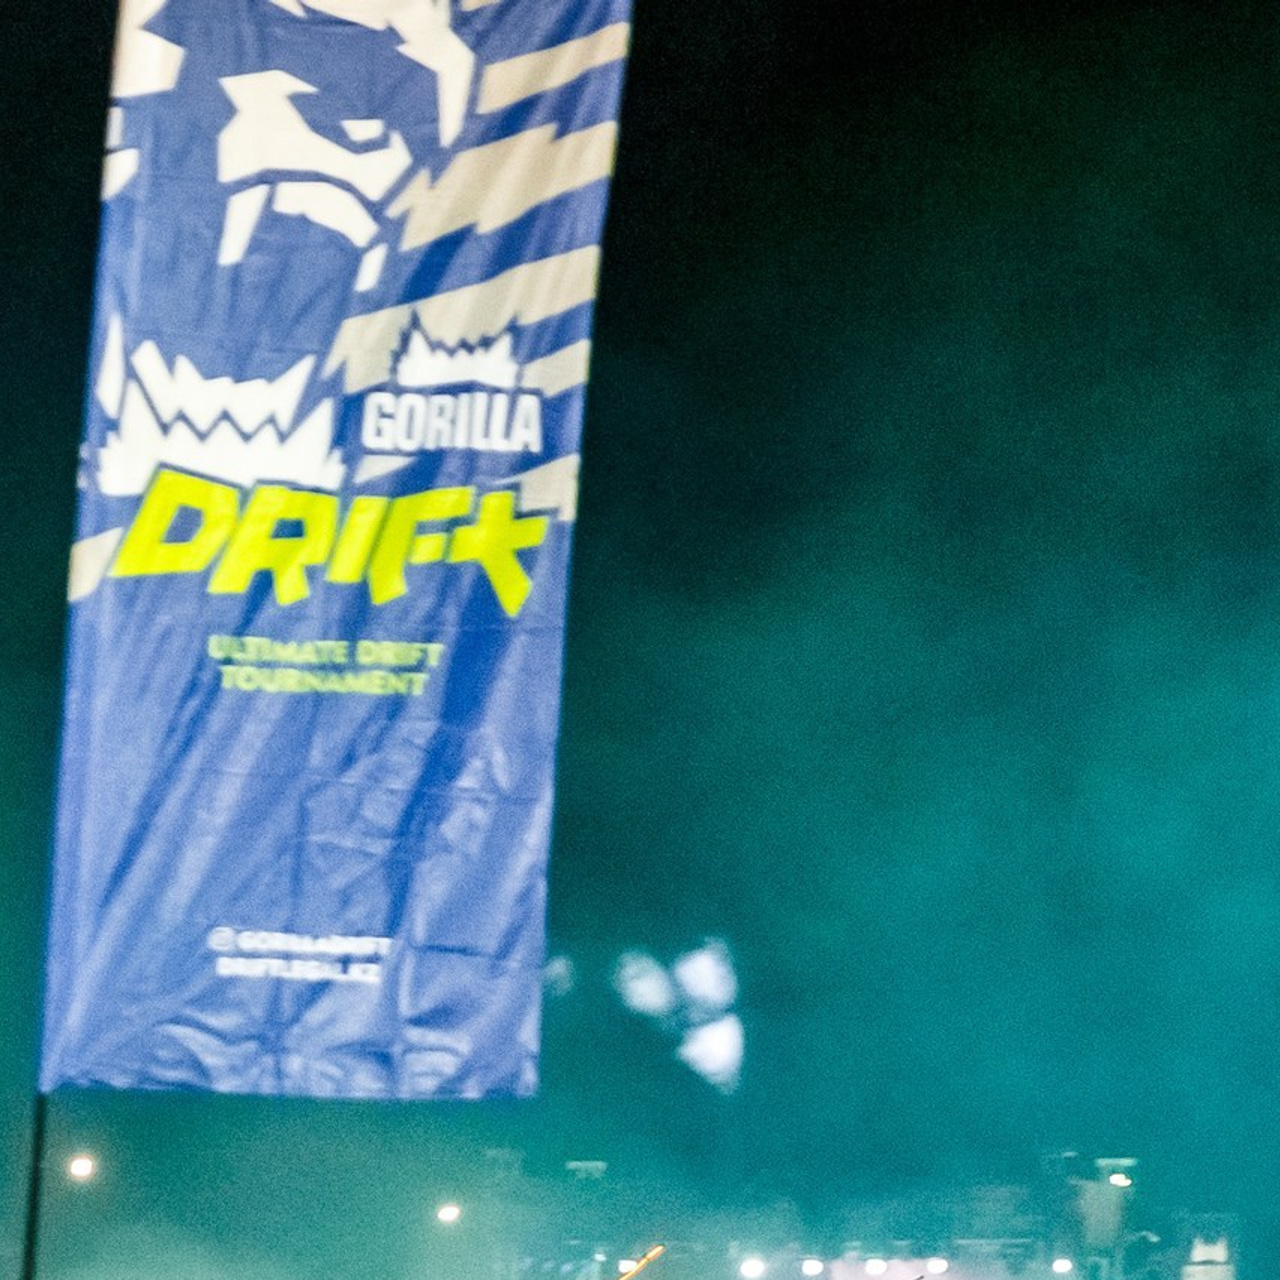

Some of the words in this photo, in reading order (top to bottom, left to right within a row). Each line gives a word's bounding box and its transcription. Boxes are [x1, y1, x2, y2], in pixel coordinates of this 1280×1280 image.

[363, 392, 542, 452] GORILLA
[108, 468, 548, 617] DRIFT
[208, 635, 348, 664] ULTIMATE
[357, 640, 444, 667] DRIFT
[219, 666, 428, 695] TOURNAMENT
